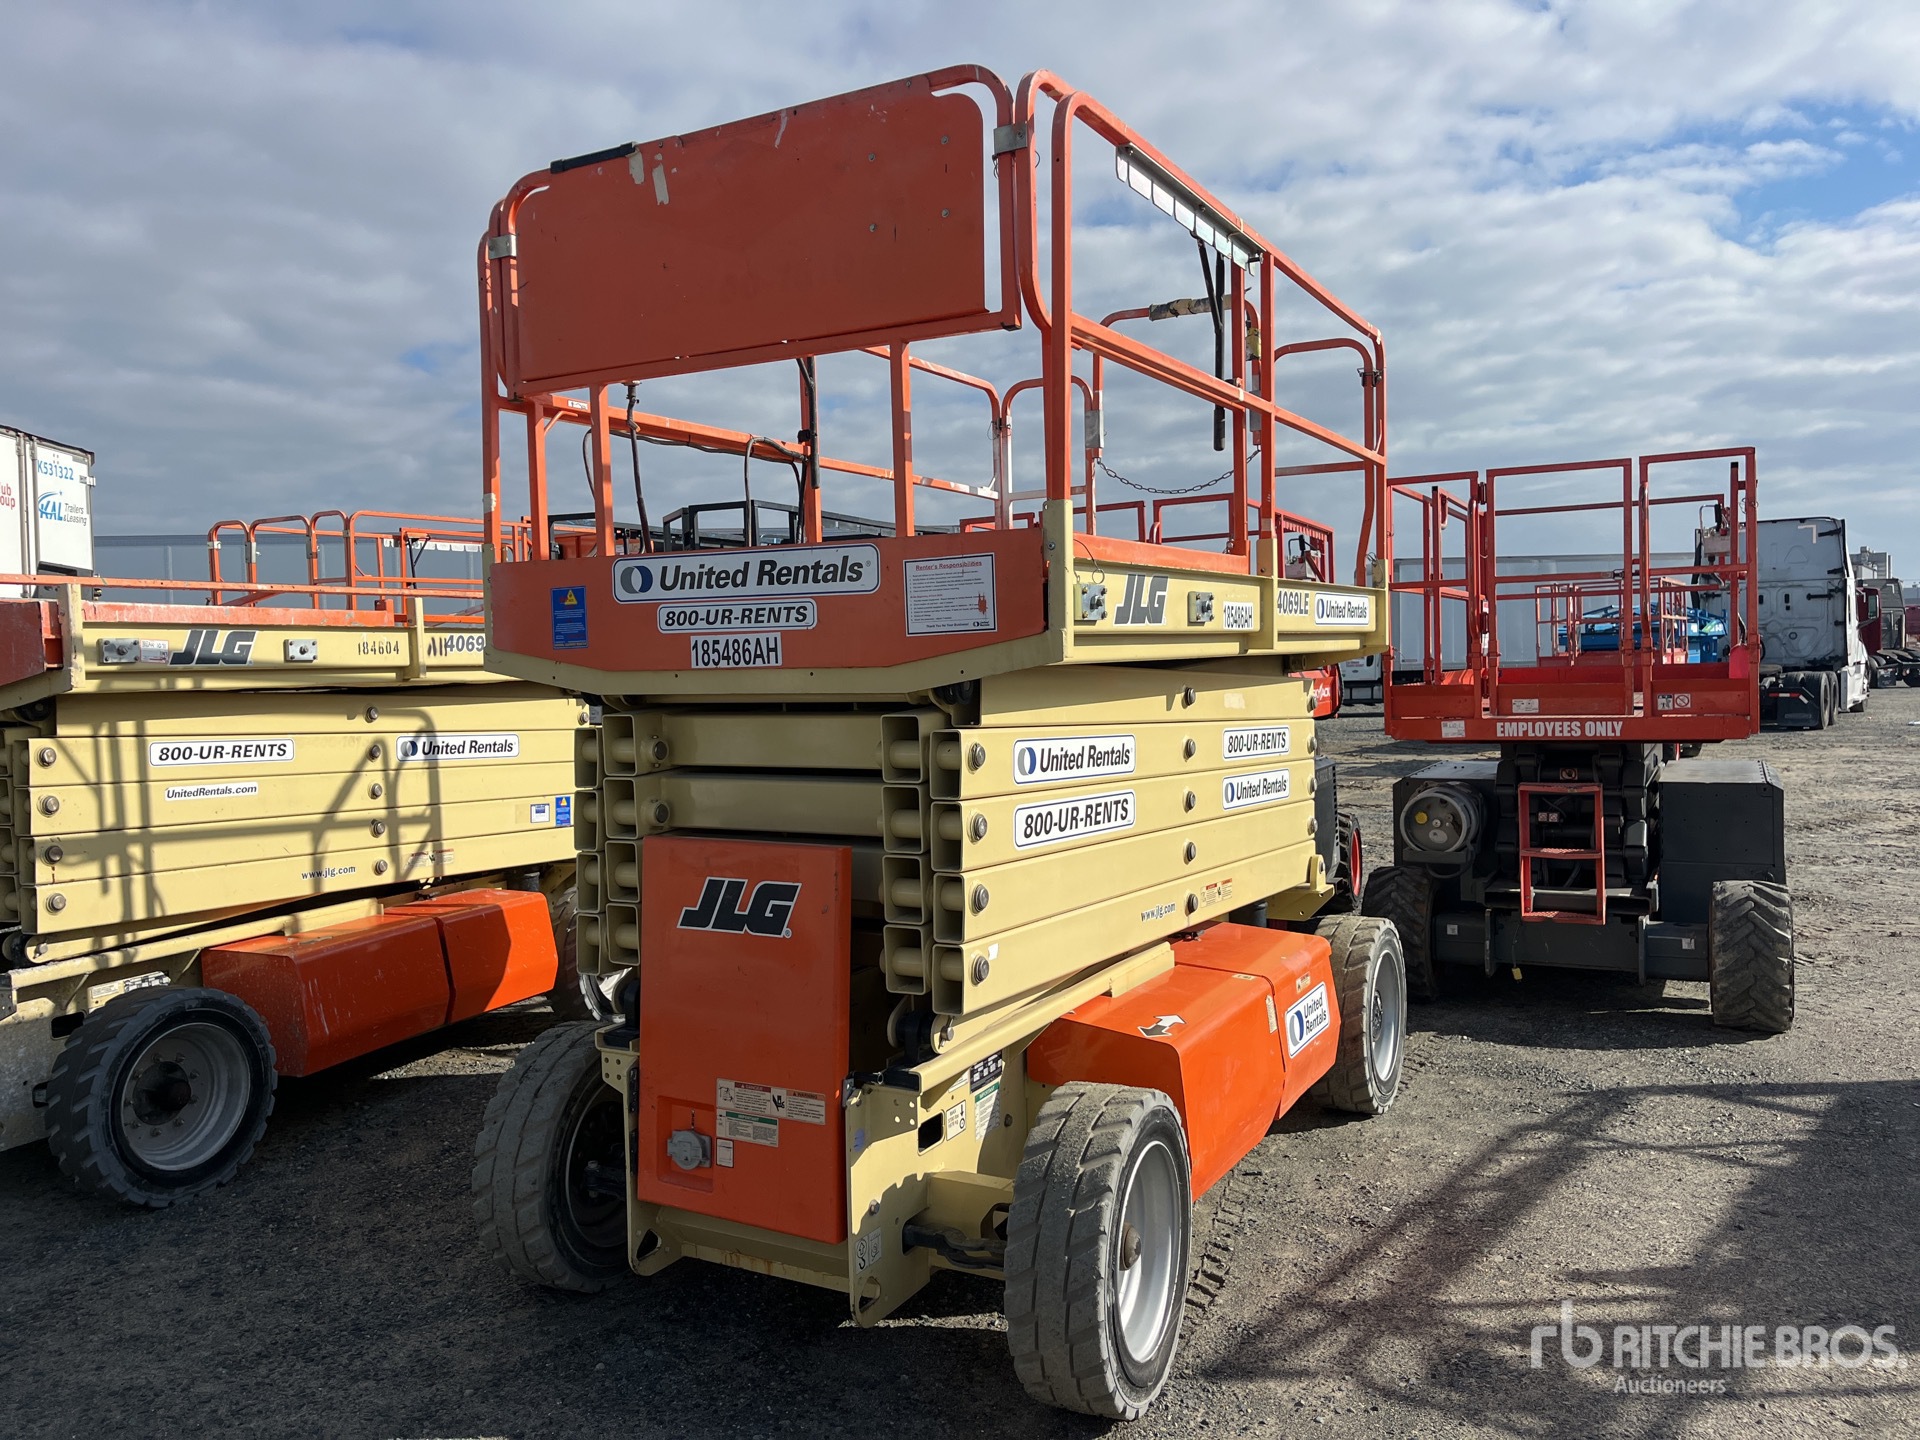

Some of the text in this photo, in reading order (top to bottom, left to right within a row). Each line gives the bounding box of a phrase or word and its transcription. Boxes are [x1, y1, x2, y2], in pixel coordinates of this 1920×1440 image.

[37, 460, 74, 481] K531322
[0, 483, 12, 496] ub
[64, 503, 84, 515] Trailers
[660, 557, 864, 591] United Rentals
[915, 563, 938, 571] Renter's
[1113, 573, 1169, 627] JLG
[1277, 590, 1309, 616] 4069LE
[1325, 600, 1367, 619] United Rentals
[664, 605, 808, 626] 800-UR-RENTS
[1223, 603, 1253, 630] 185486AH
[168, 629, 257, 666] JLG
[691, 635, 780, 668] 185486AH
[1496, 721, 1623, 738] EMPLOYEES ONLY
[158, 743, 287, 762] 800-UR-RENTS
[422, 739, 514, 756] United Rentals
[1227, 730, 1287, 754] 800-UR-RENTS
[1040, 742, 1131, 773] United Rentals
[166, 785, 257, 799] UnitedRentals.com
[1236, 776, 1287, 800] United Rentals
[1023, 799, 1130, 839] 800-UR-RENTS
[301, 866, 356, 880] www.jlg.com
[676, 876, 802, 938] JLG
[1140, 903, 1176, 921] www.jlg.com
[1303, 991, 1323, 1019] United
[1305, 1010, 1327, 1036] Rentals
